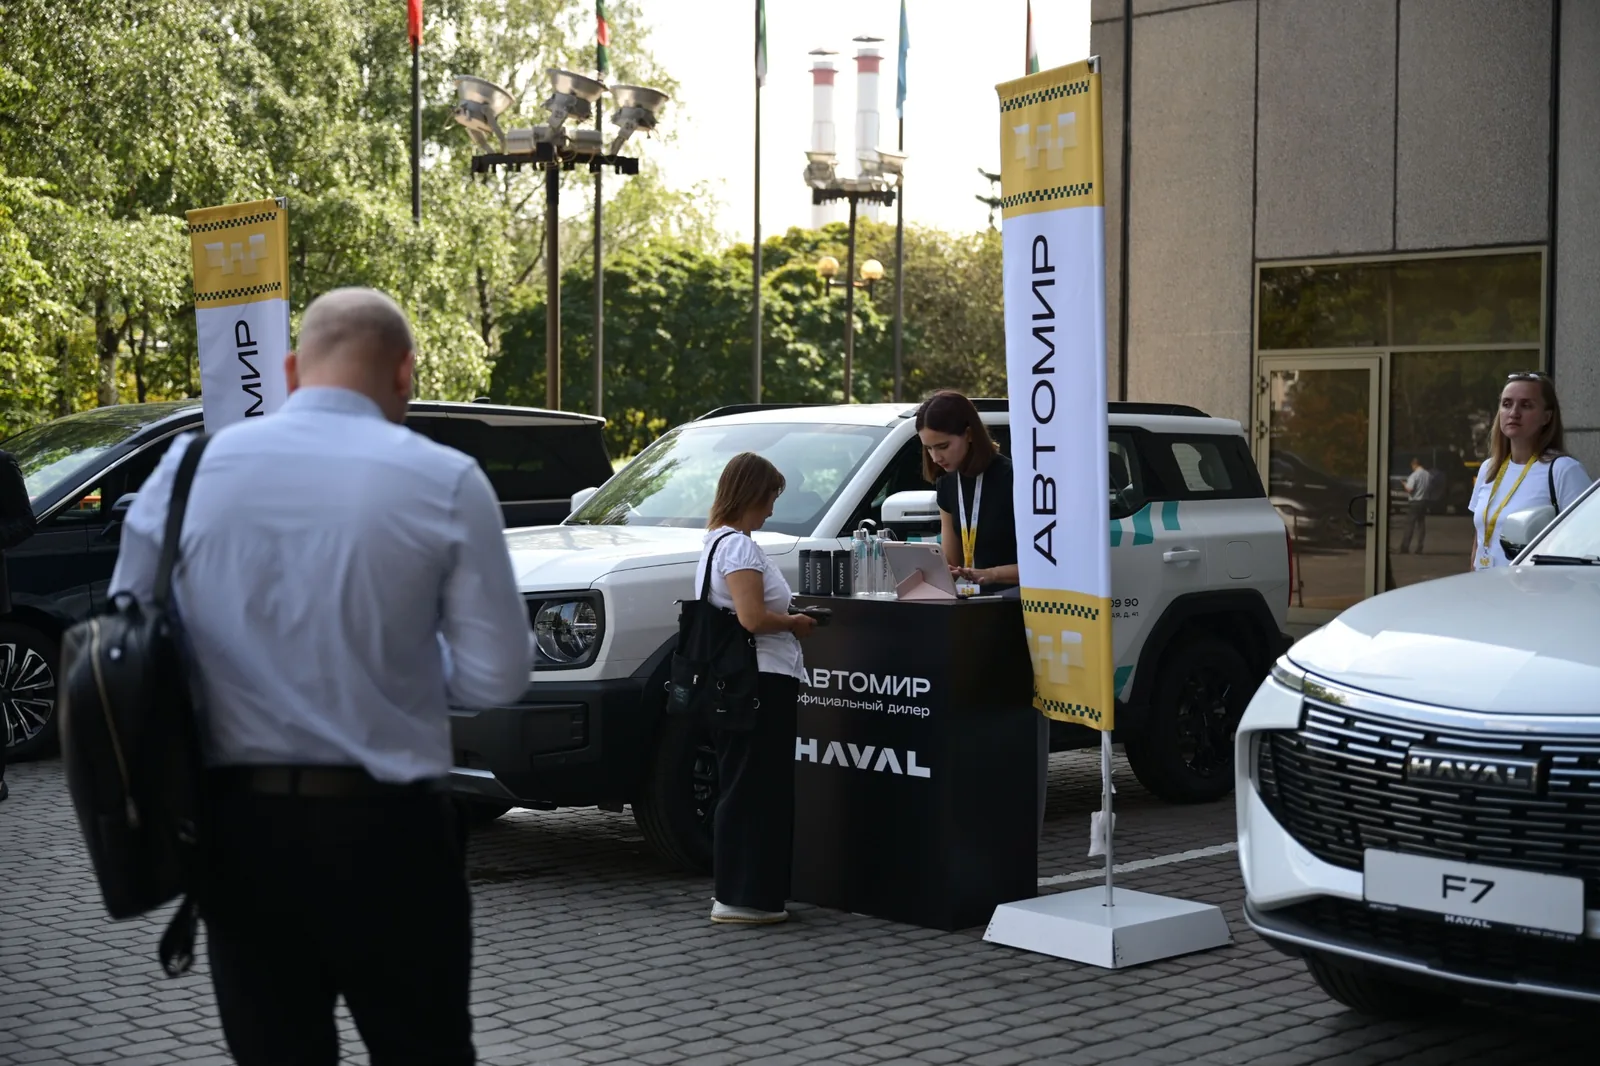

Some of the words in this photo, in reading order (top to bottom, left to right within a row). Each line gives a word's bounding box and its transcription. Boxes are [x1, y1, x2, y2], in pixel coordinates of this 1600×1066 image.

[234, 319, 265, 418] МИР
[1031, 234, 1057, 566] АВТОМИР
[1124, 598, 1139, 607] 90
[887, 703, 931, 719] дилер
[794, 736, 931, 778] HAVAL
[1409, 755, 1529, 787] HAVAL
[1441, 873, 1496, 904] F7
[1444, 912, 1492, 929] HAVAL
